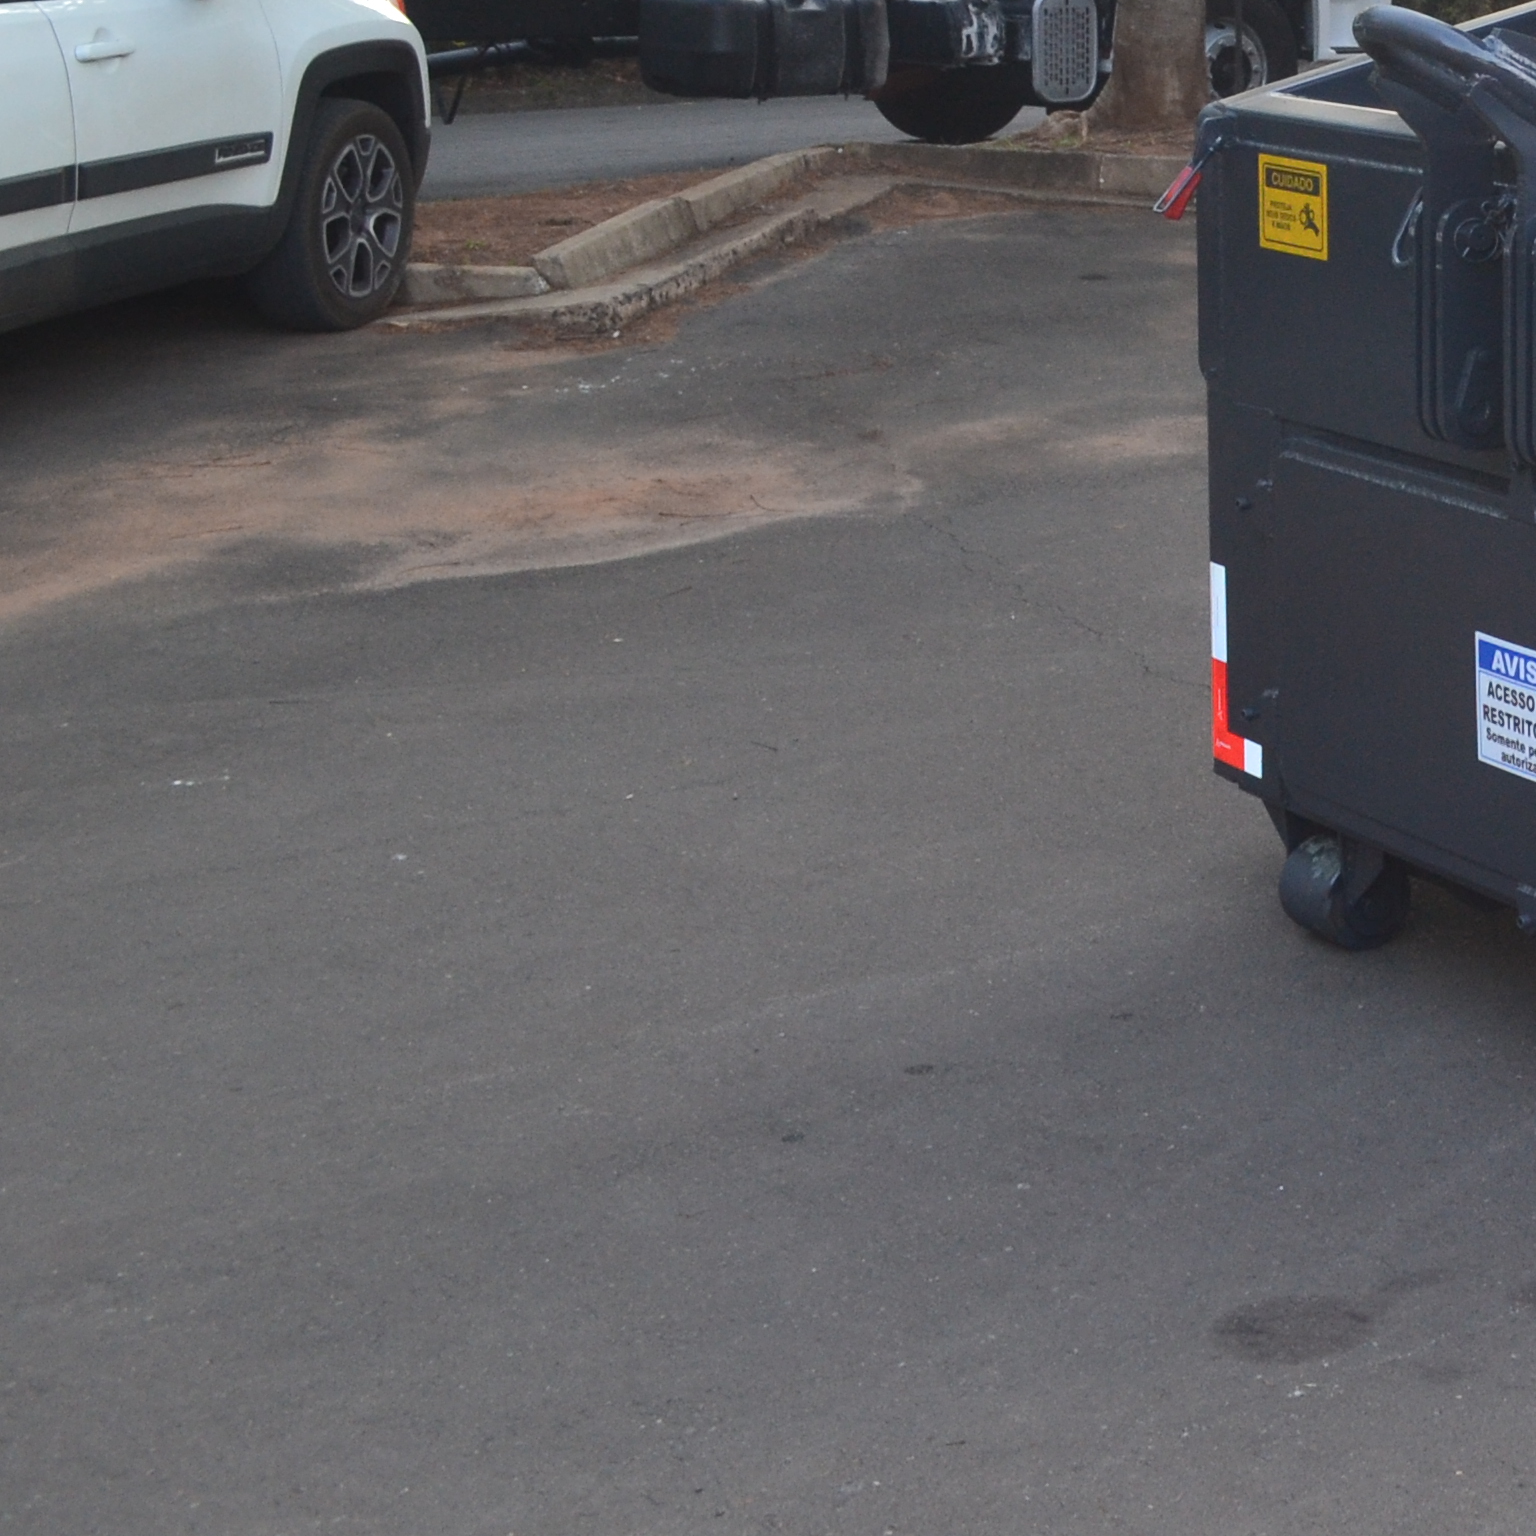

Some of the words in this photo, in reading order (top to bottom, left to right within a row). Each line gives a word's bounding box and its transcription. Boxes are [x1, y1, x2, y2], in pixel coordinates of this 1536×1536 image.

[1271, 172, 1313, 192] CUIDADO
[1487, 680, 1535, 713] ACESSO
[1486, 727, 1526, 754] Somente
